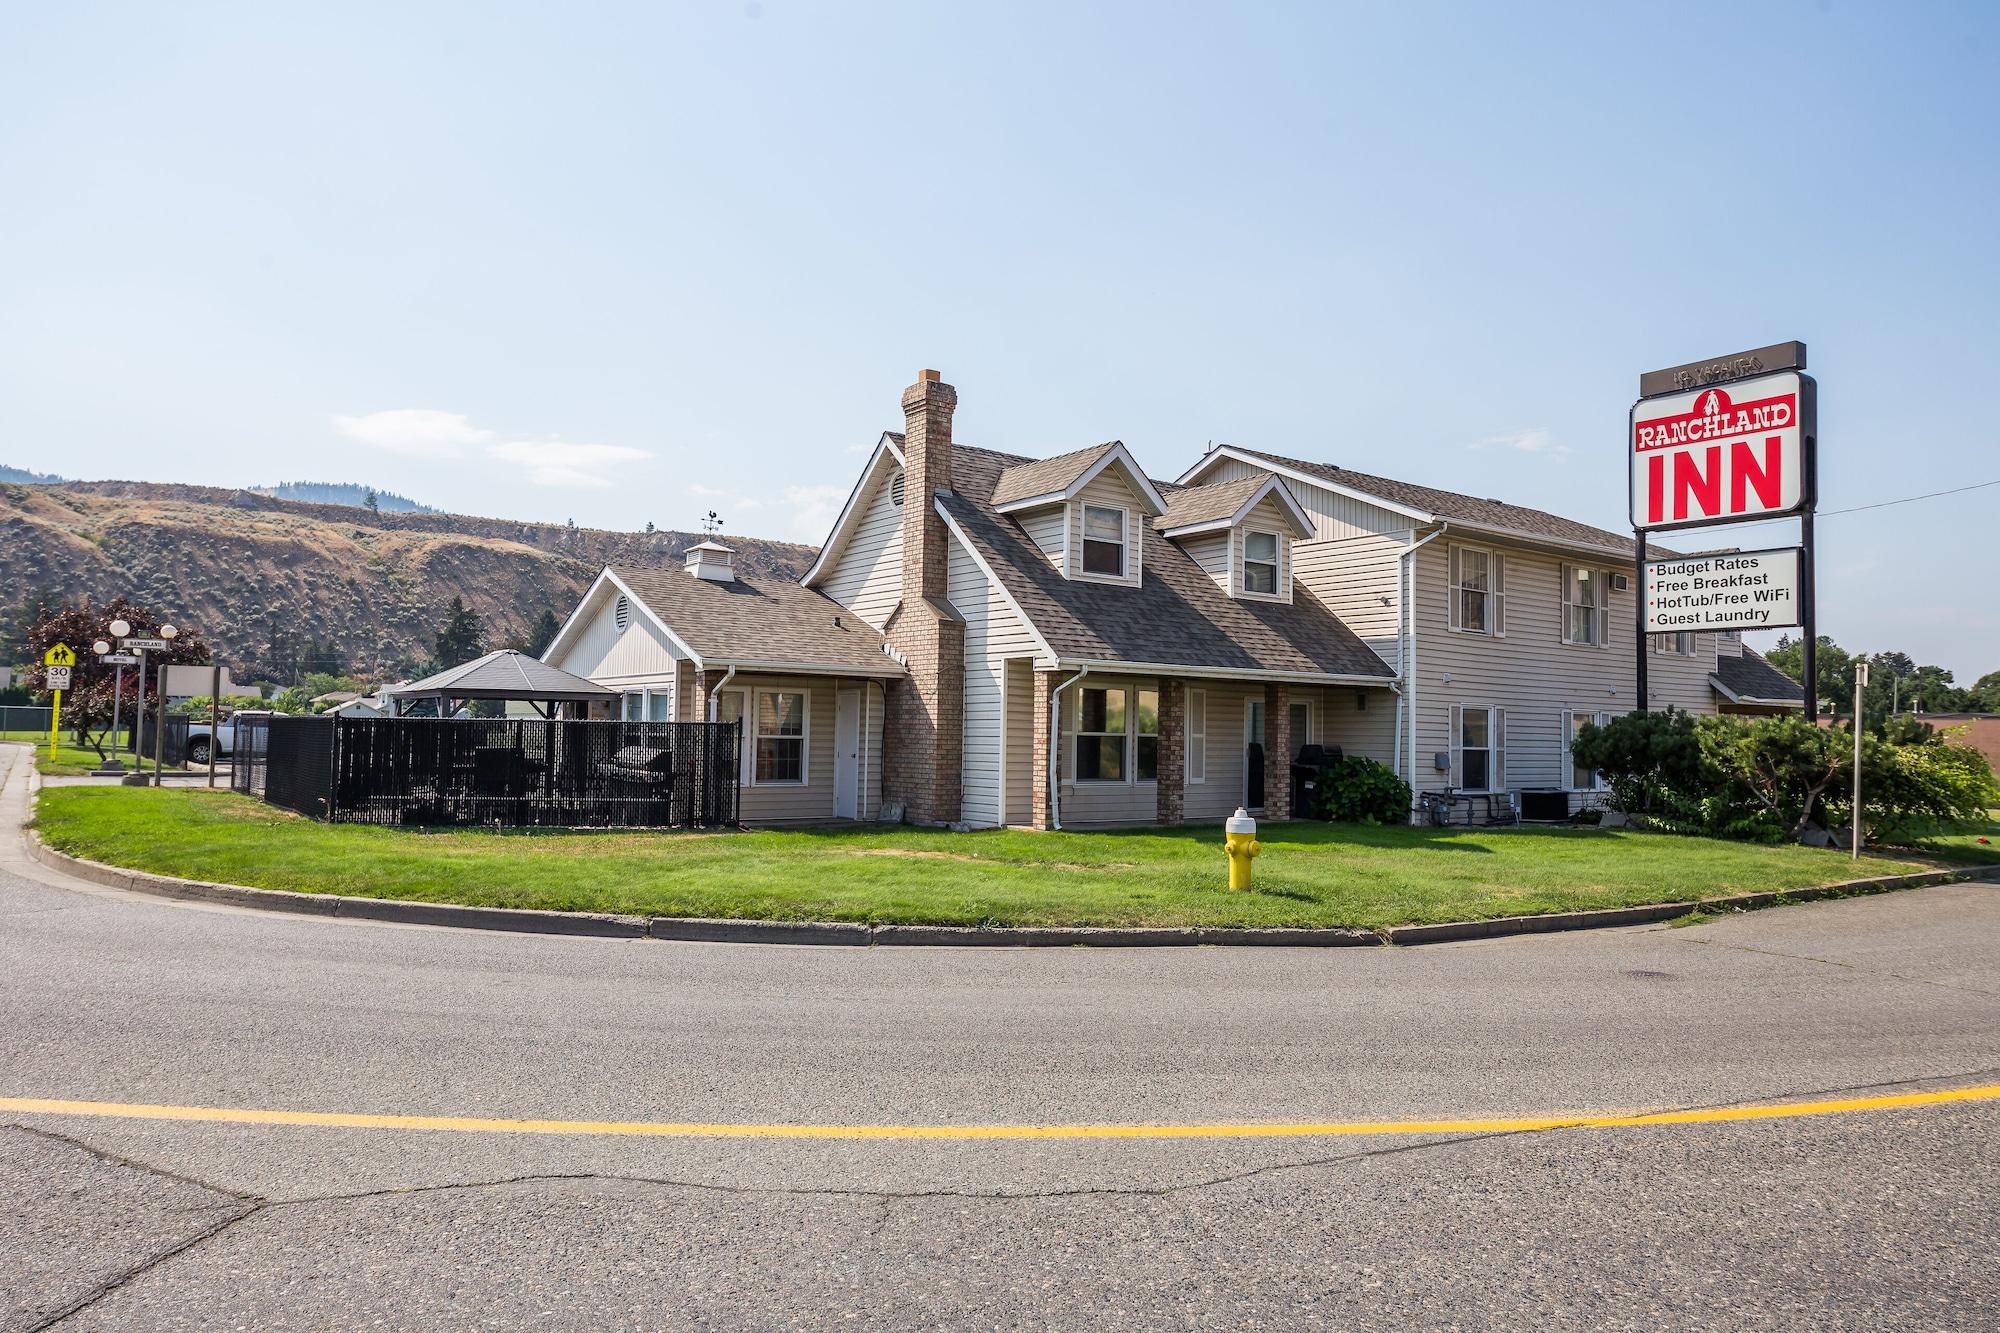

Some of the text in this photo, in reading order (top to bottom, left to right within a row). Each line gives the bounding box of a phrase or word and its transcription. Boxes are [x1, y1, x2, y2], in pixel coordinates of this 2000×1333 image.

[1638, 403, 1791, 449] RANCHLAND
[1649, 436, 1781, 523] INN
[1656, 558, 1759, 577] Budget Rates
[1657, 573, 1769, 593] Free Breakfast
[1657, 588, 1789, 609] HotTub/Free WiFi
[1656, 608, 1770, 625] Guest Laundry
[51, 667, 68, 676] 30
